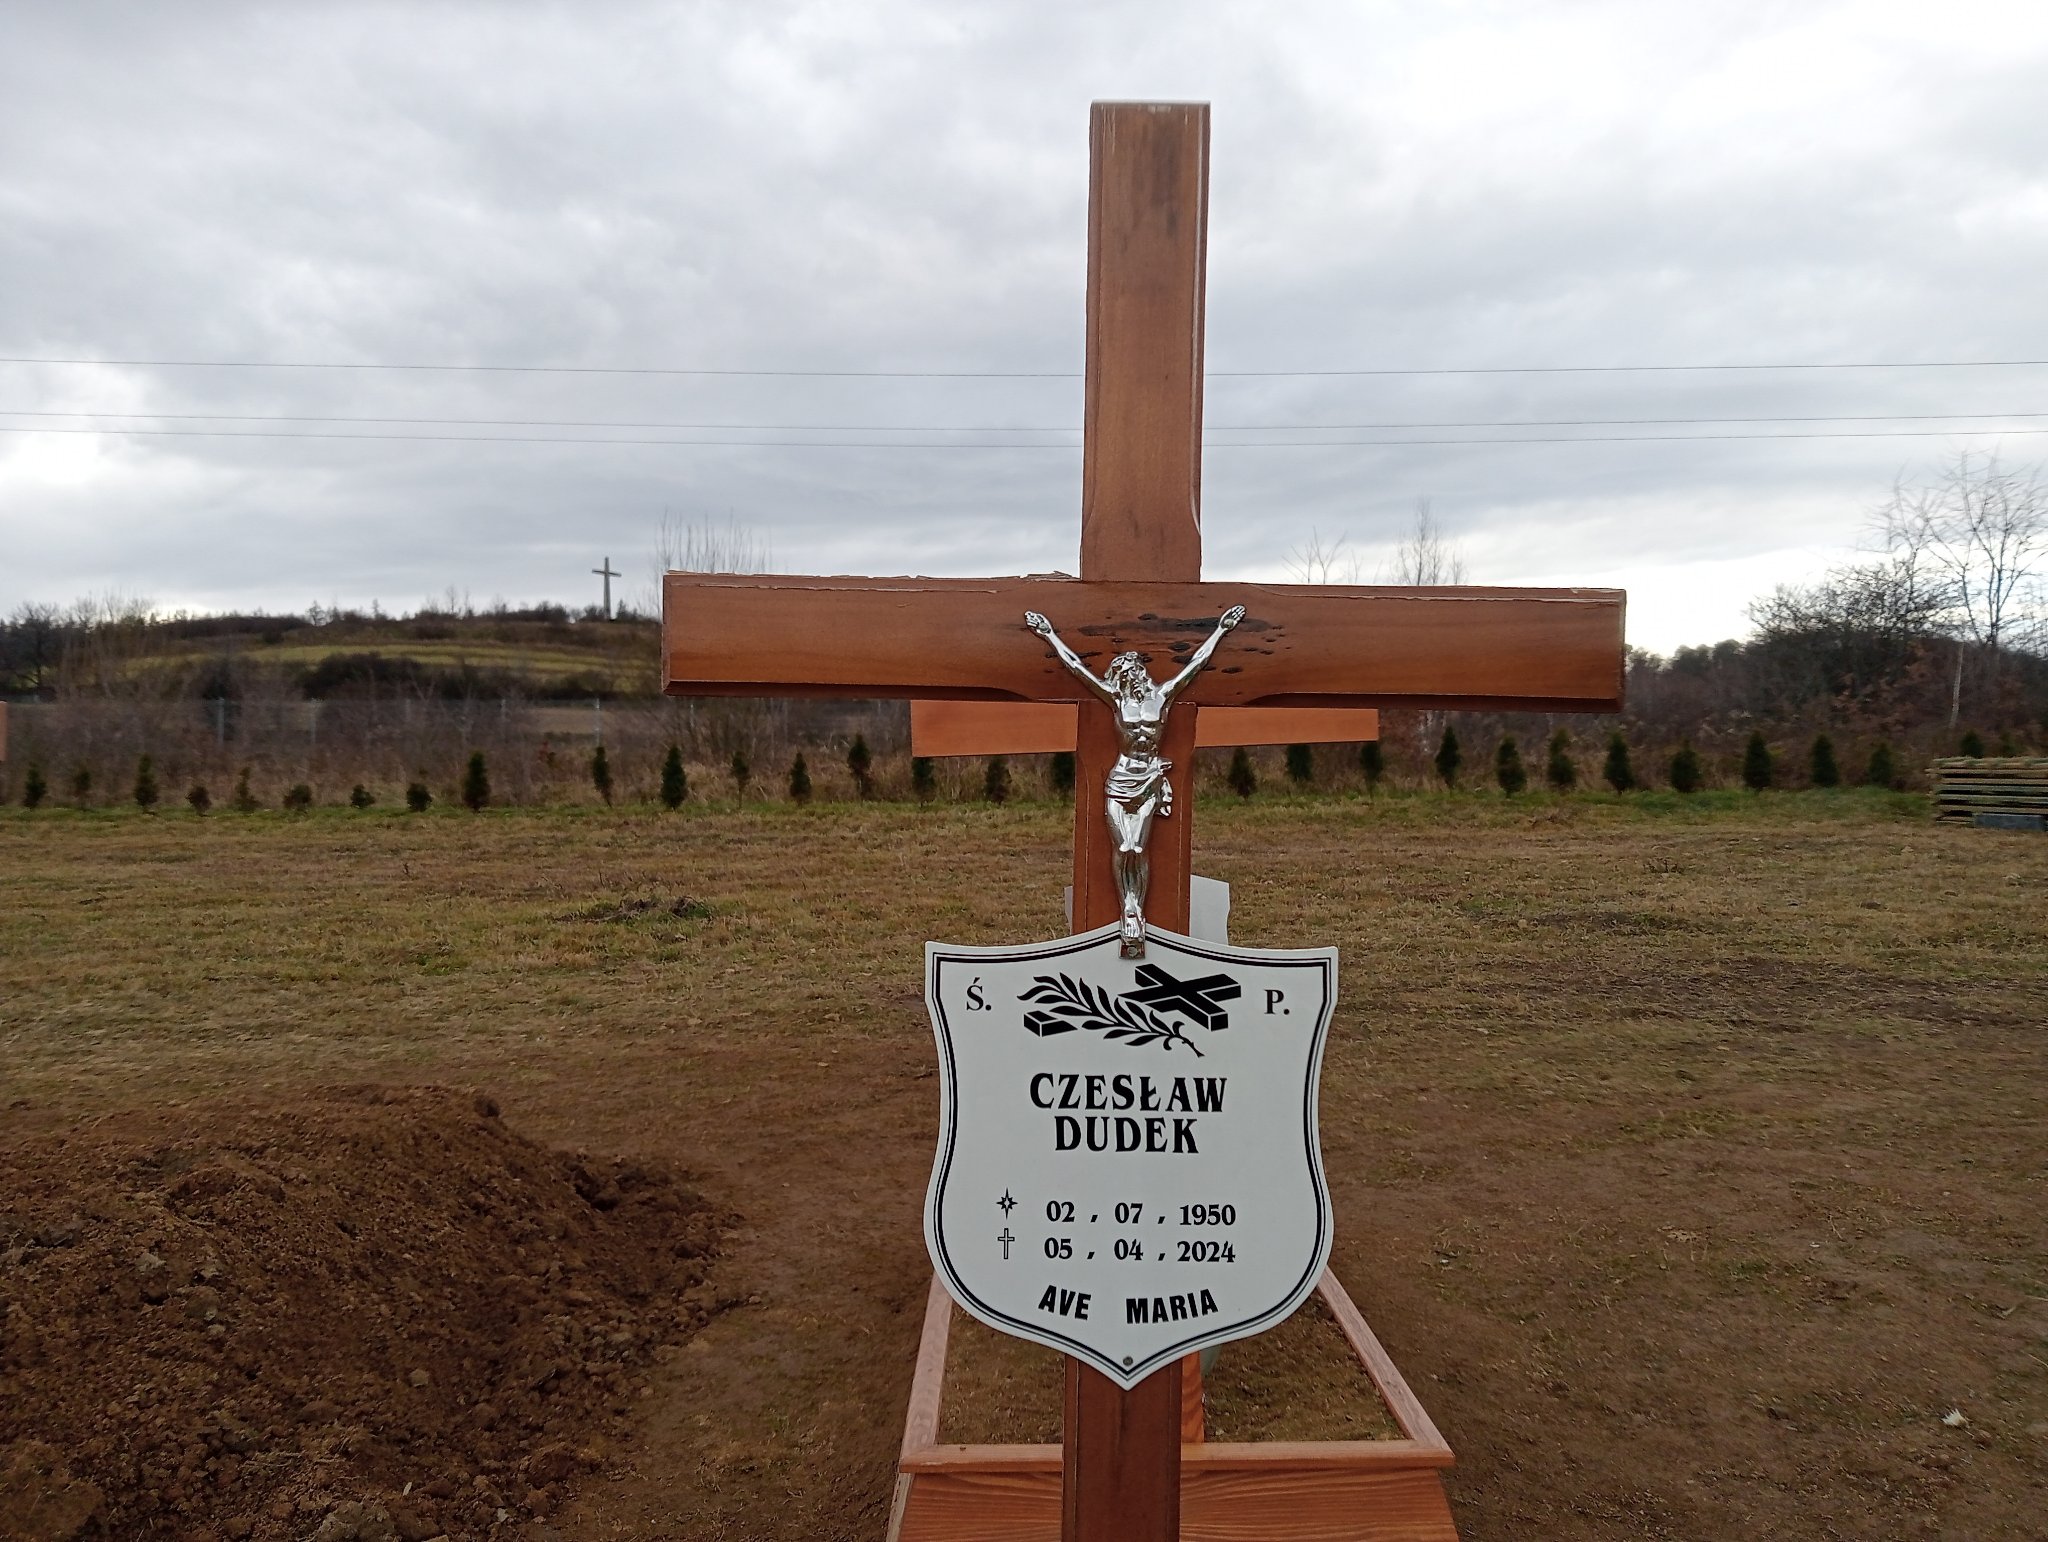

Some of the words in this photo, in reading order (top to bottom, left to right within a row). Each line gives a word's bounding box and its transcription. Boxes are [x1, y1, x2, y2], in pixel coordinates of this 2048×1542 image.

[966, 976, 992, 1012] Ś.
[1264, 989, 1290, 1016] P.
[1029, 1072, 1228, 1113] CZESŁAW
[1054, 1115, 1200, 1154] DUDEK
[1179, 1203, 1237, 1226] 1950
[1176, 1240, 1236, 1263] 2024
[1037, 1284, 1092, 1321] AVE
[1125, 1288, 1219, 1325] MARIA
